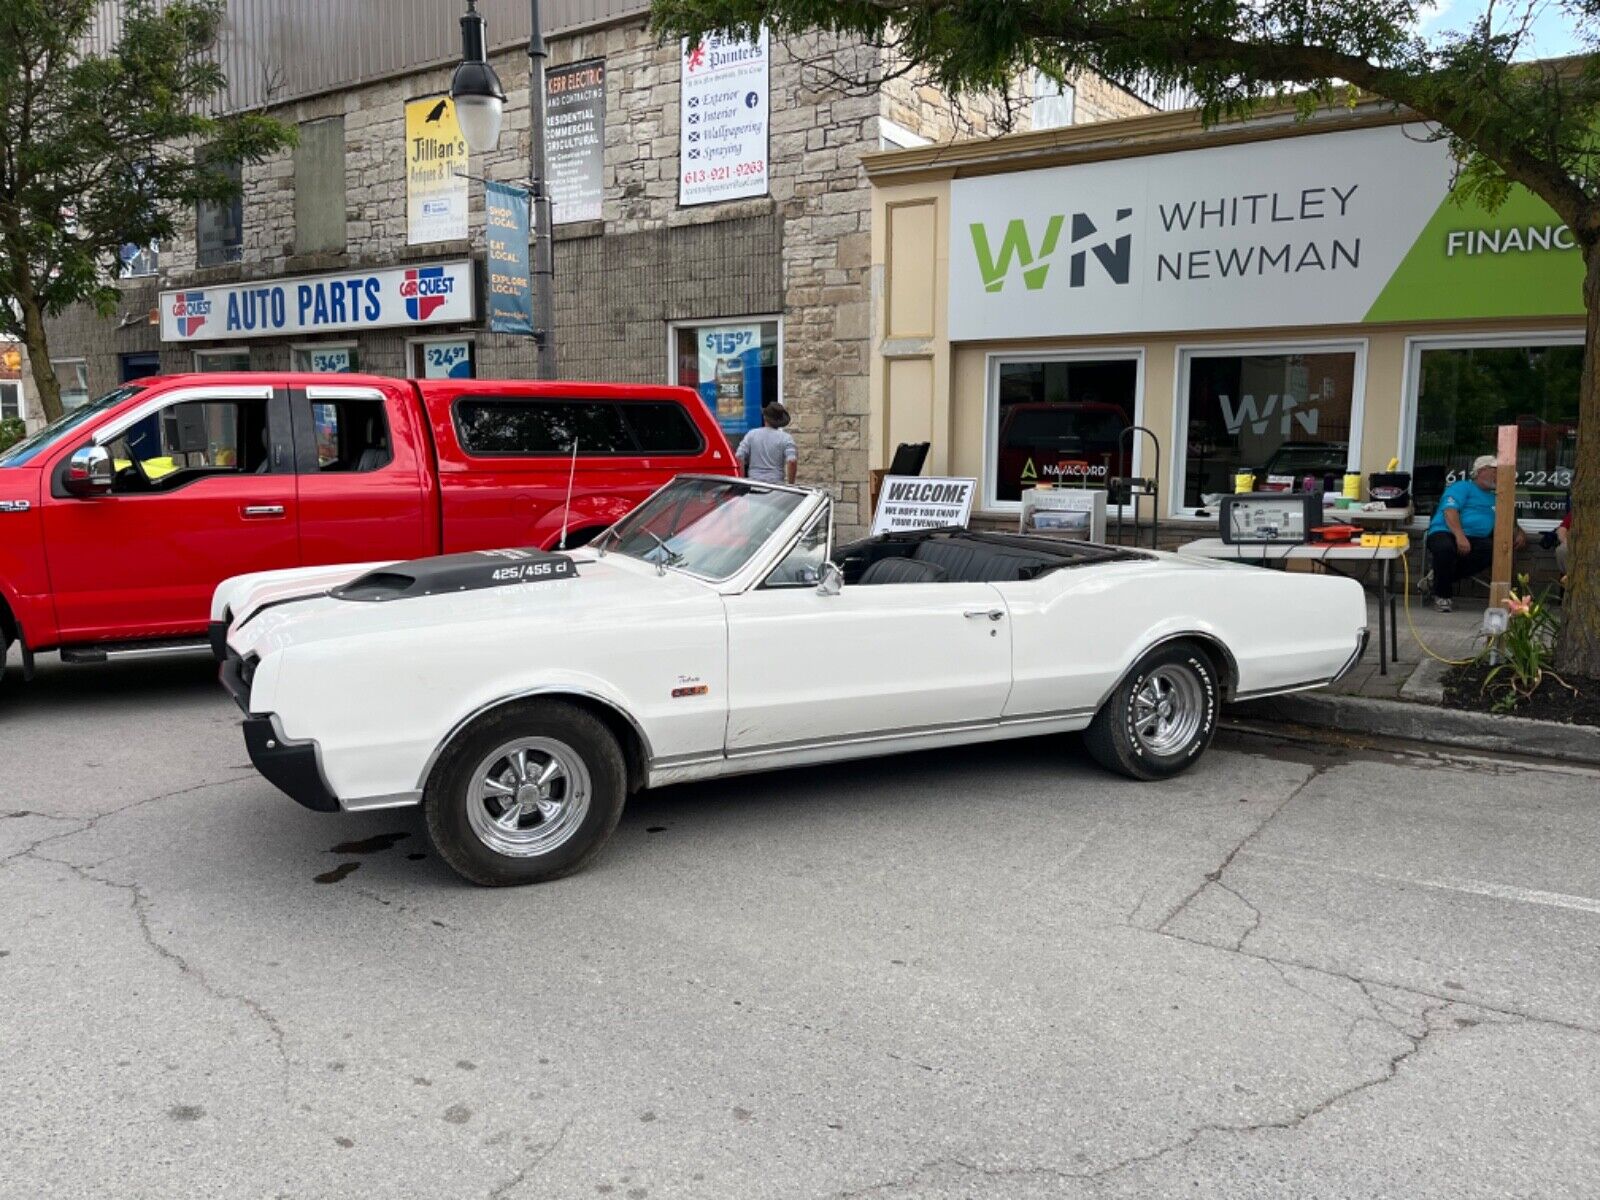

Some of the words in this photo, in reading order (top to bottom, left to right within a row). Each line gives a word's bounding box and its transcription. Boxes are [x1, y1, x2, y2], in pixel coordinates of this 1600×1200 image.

[709, 45, 763, 70] Painters
[567, 67, 603, 91] ELECTRIC
[702, 90, 739, 107] Exterior
[703, 107, 737, 122] Interior
[703, 122, 763, 141] Wallpapering
[412, 136, 465, 162] Jillian's
[685, 160, 764, 185] 613-921-9263
[1159, 184, 1359, 233] WHITLEY
[490, 239, 505, 250] EAT
[969, 208, 1133, 293] WN
[1447, 224, 1578, 257] FINANC
[1157, 238, 1360, 281] NEWMAN
[491, 273, 528, 288] EXPLORE
[227, 286, 286, 331] AUTO
[297, 277, 381, 326] PARTS
[1218, 394, 1321, 435] WN
[887, 483, 968, 503] WELCOME
[885, 506, 897, 516] WE
[898, 507, 919, 517] HOPE
[920, 508, 936, 518] YOU
[936, 509, 961, 519] ENJOY
[891, 517, 912, 527] YOUR
[491, 564, 552, 580] 425/455
